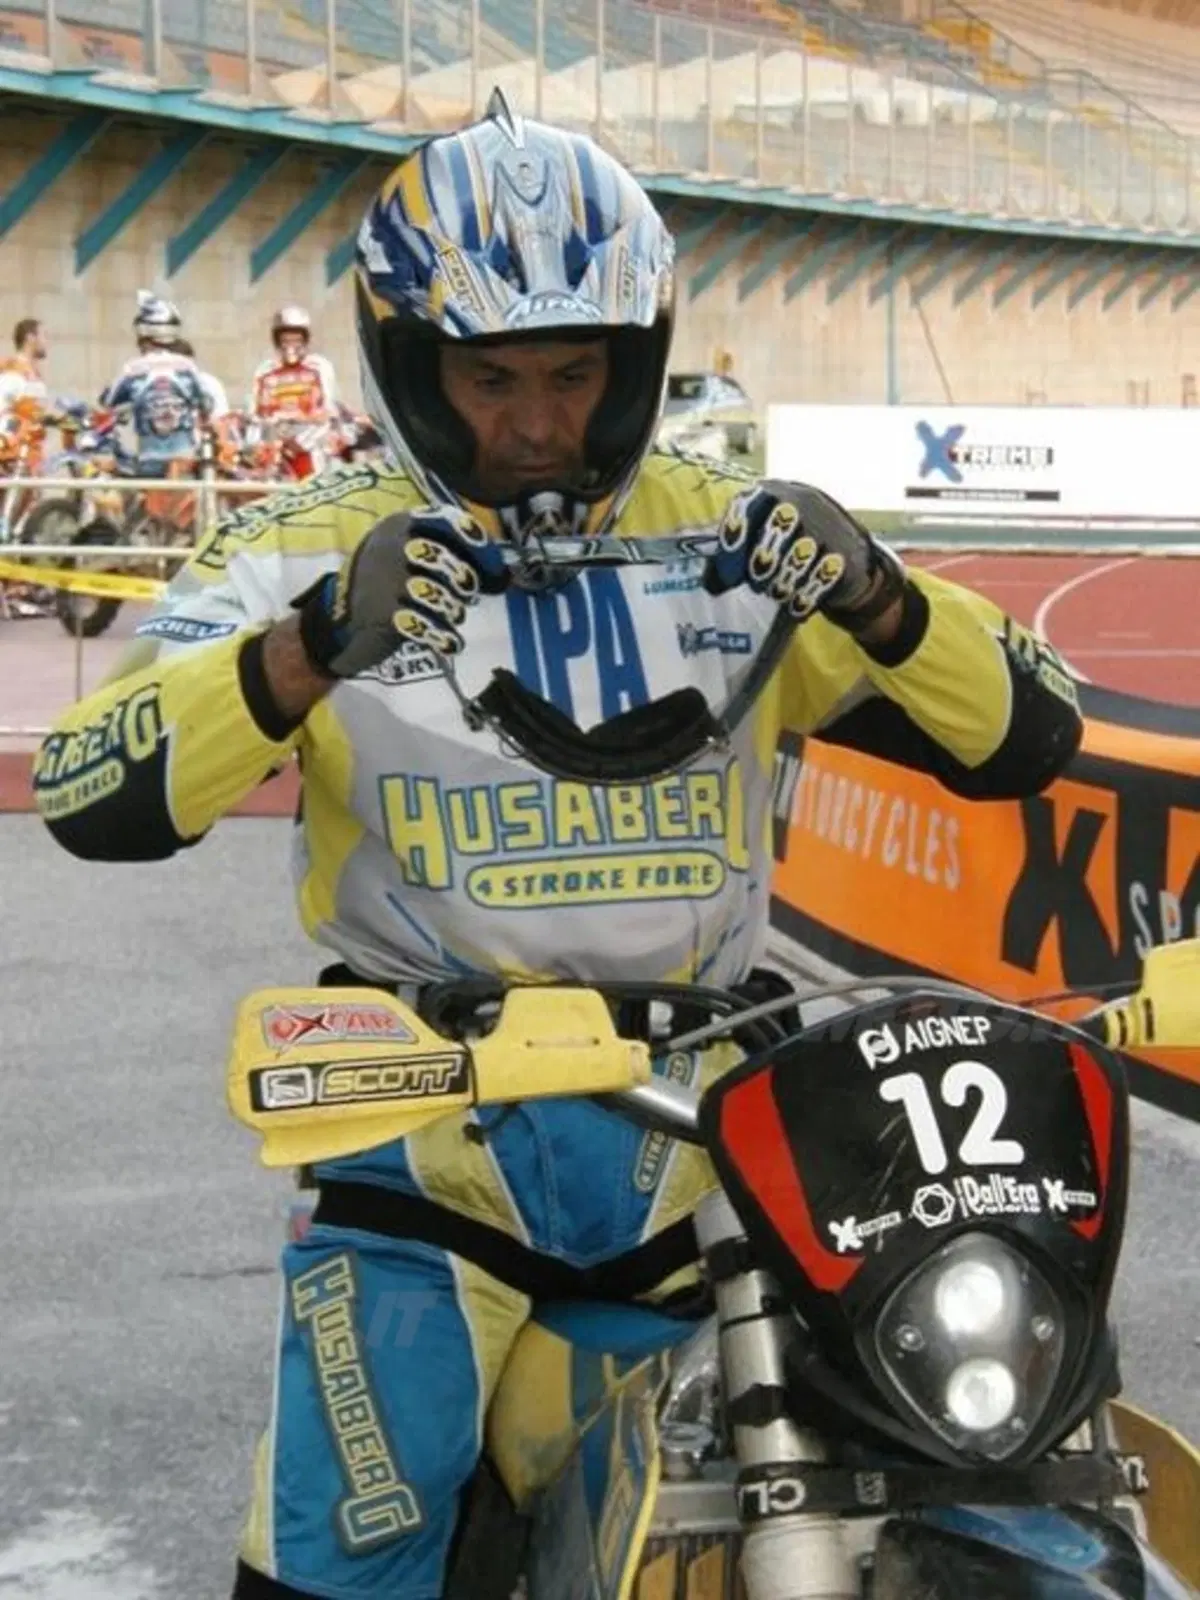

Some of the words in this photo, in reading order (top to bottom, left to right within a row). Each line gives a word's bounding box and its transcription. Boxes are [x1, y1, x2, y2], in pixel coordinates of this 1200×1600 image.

[477, 880, 493, 896] 4
[503, 868, 624, 896] STROKE
[905, 1016, 991, 1053] AIGNEP
[325, 1062, 454, 1095] SCOTT
[879, 1060, 1025, 1175] 12
[292, 1255, 422, 1545] HUSABERG
